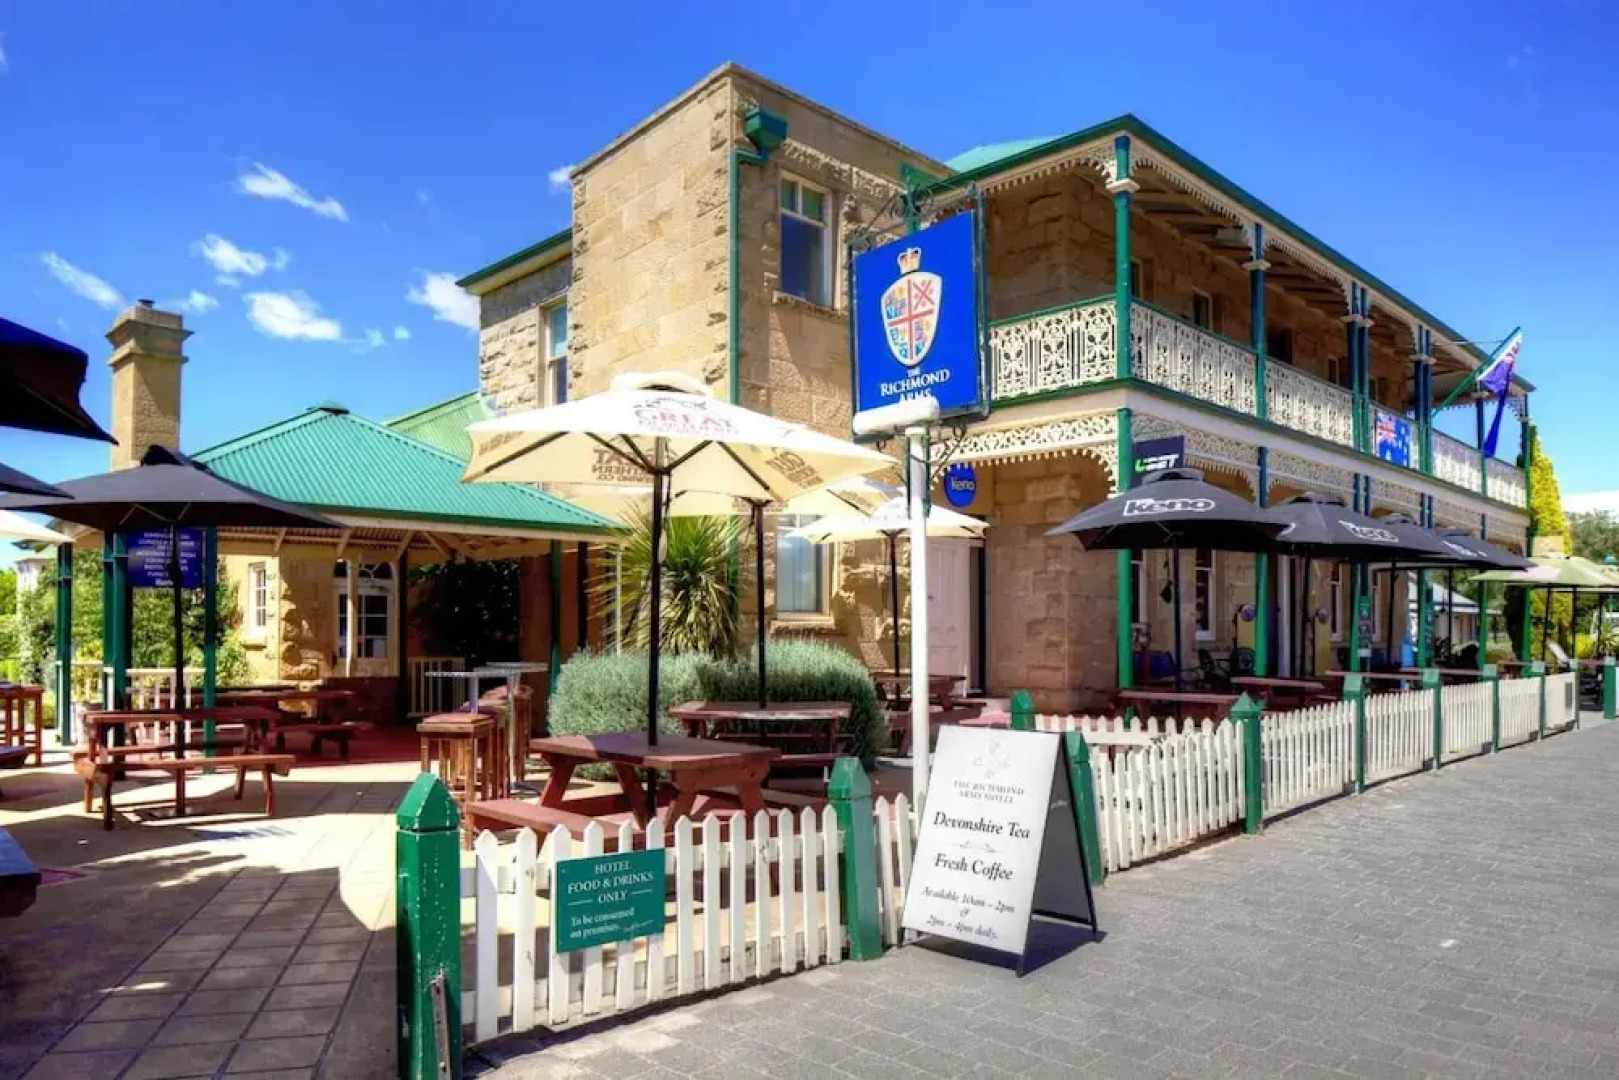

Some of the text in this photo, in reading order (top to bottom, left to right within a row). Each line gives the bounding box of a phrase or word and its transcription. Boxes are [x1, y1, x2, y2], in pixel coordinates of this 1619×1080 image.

[880, 368, 950, 396] RICHMOND
[1123, 498, 1216, 517] Keno
[933, 810, 1031, 839] Devonshire Tea
[595, 861, 632, 875] HOTEL
[934, 852, 1014, 881] Fresh Coffee
[567, 871, 654, 895] FOOD & DRINKS
[598, 889, 628, 904] ONLY
[571, 906, 635, 927] To be consumed
